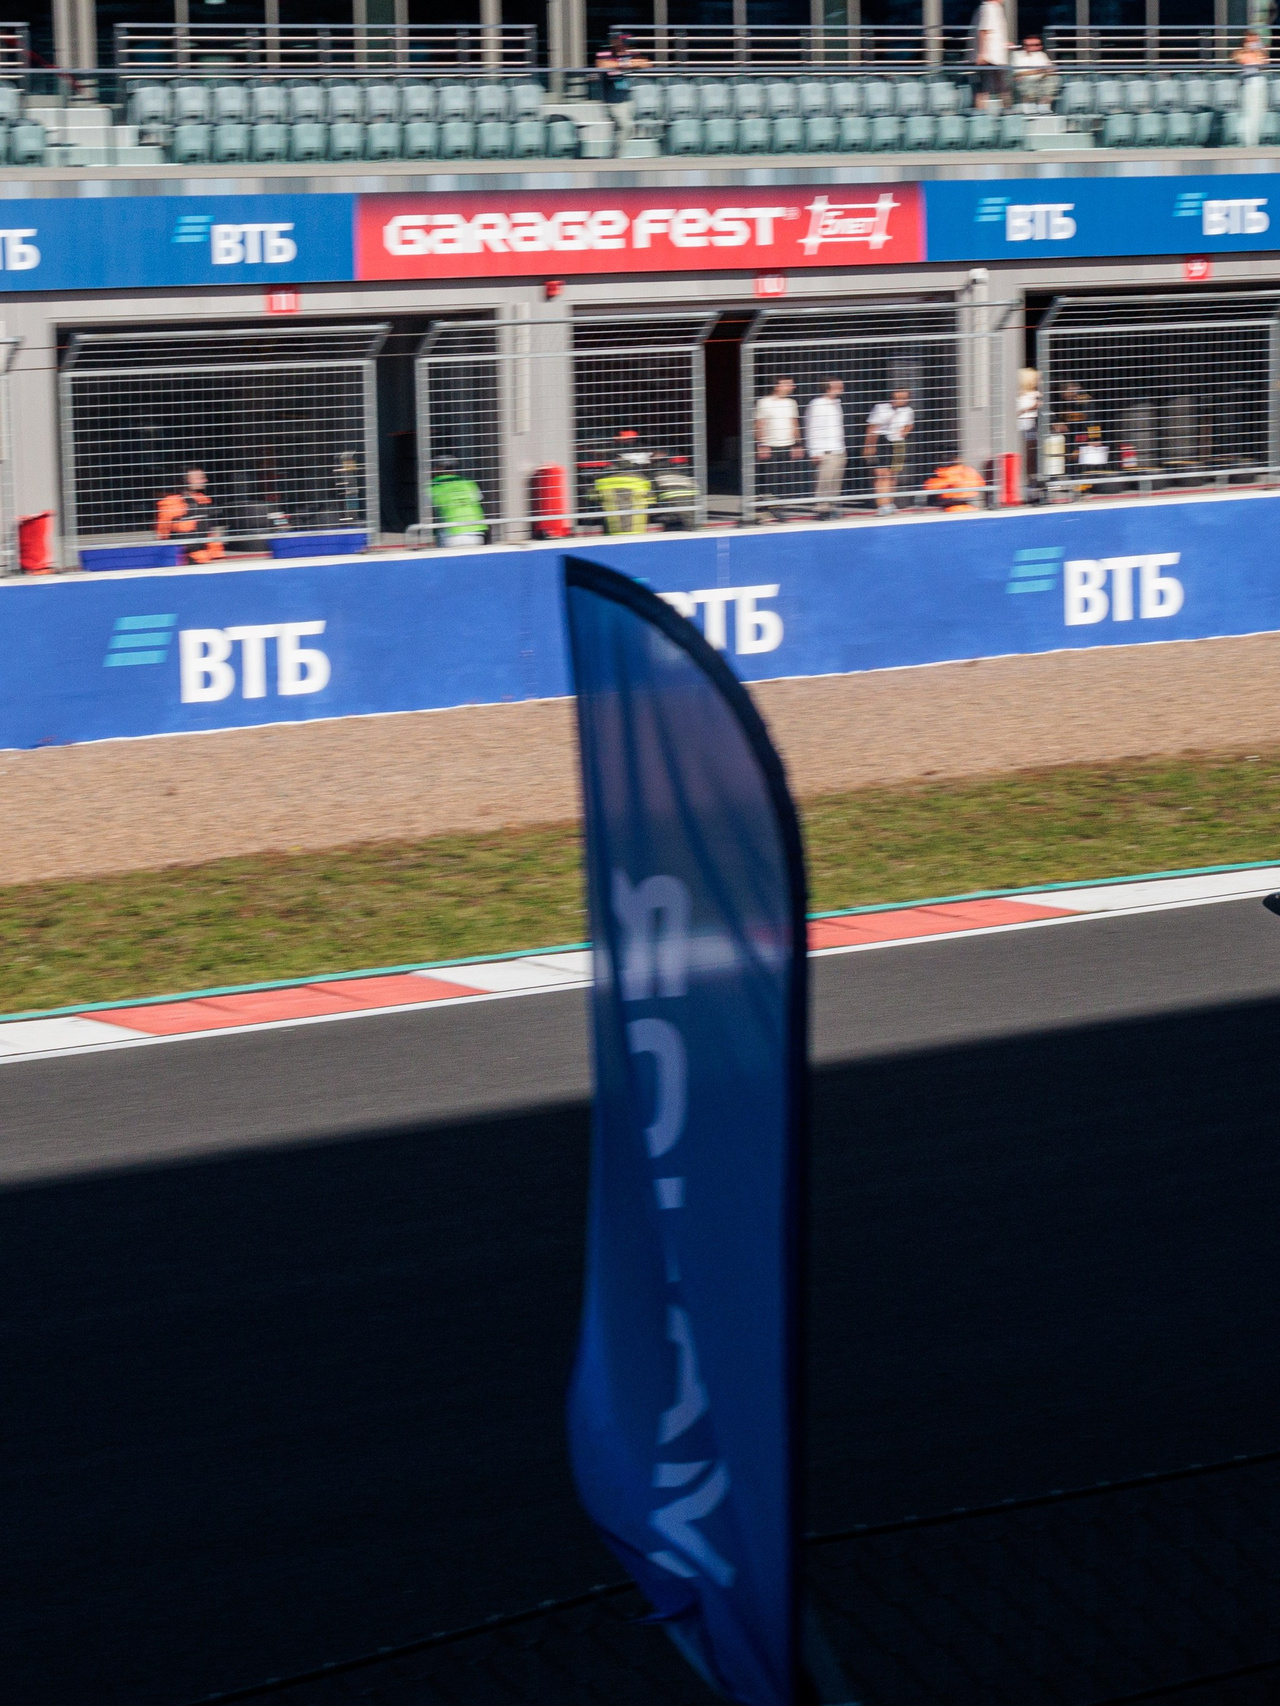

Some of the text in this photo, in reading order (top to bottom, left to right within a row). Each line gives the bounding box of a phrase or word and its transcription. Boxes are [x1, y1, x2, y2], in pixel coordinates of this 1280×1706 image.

[211, 222, 297, 265] ВТБ
[1005, 203, 1076, 241] ВТБ
[1202, 198, 1269, 235] ВТБ
[1063, 551, 1185, 626] ВТБ
[654, 583, 784, 655] ТБ
[179, 620, 331, 703] ВТБ
